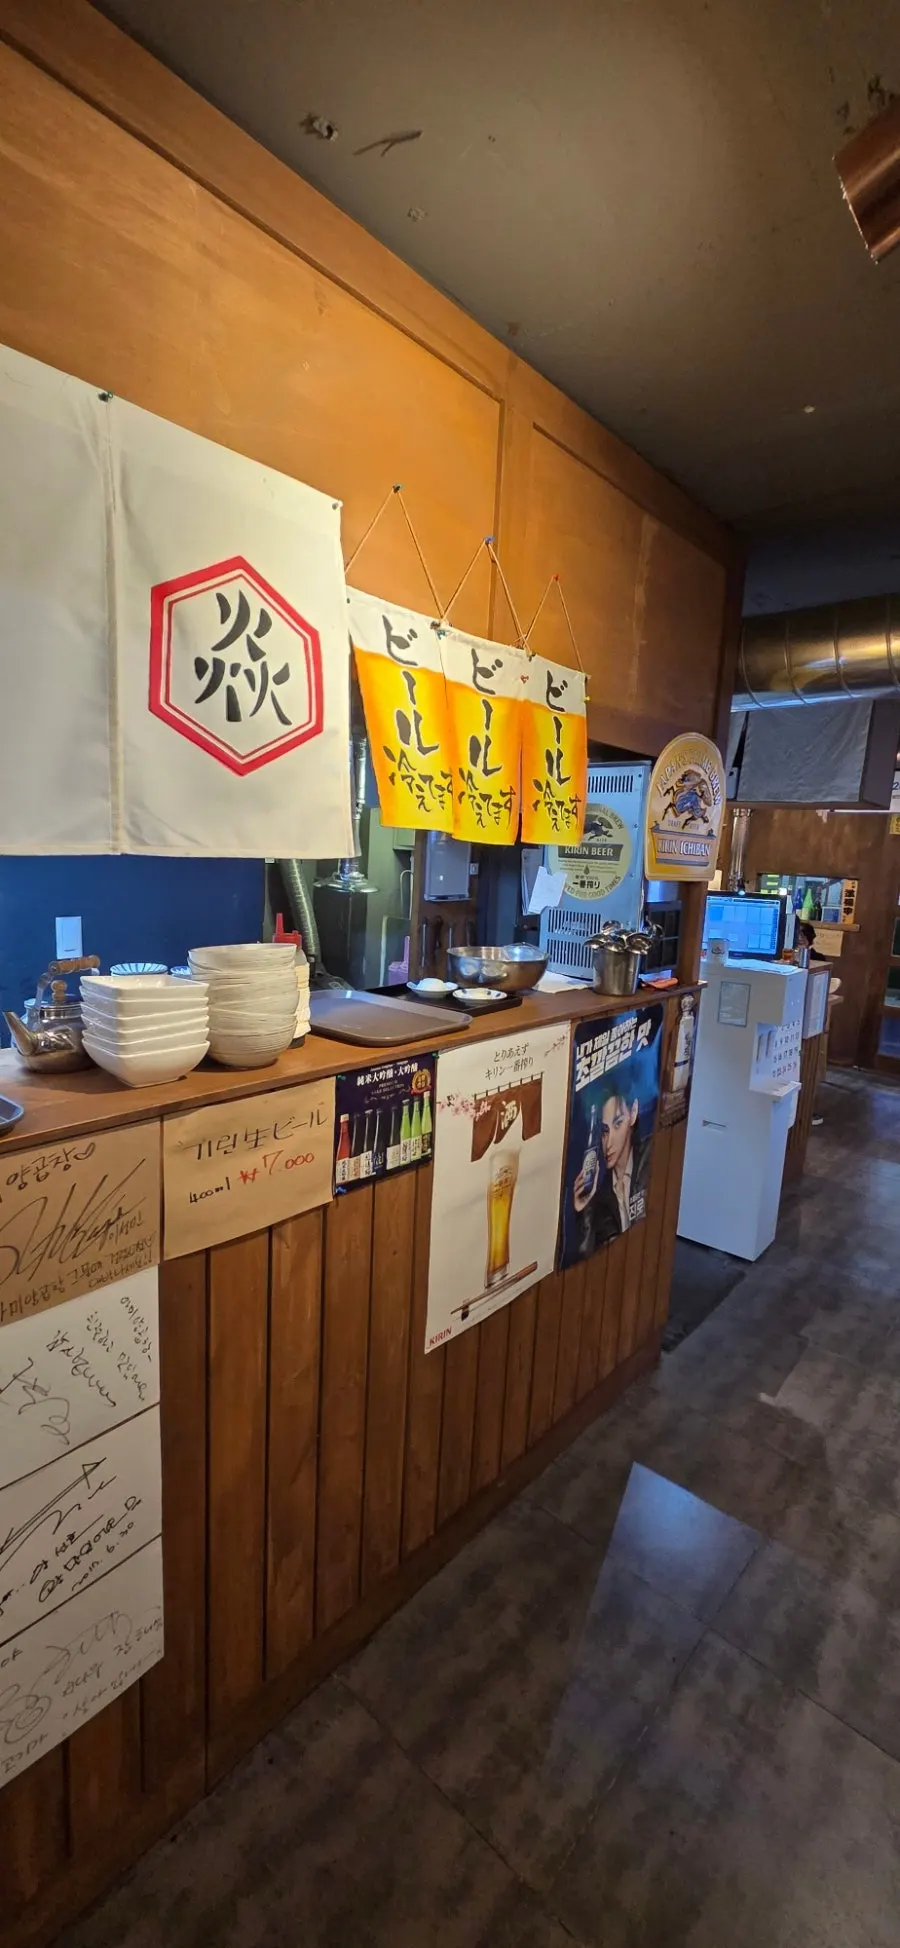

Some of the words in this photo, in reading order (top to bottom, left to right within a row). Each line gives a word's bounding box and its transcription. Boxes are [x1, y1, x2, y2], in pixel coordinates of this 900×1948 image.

[382, 614, 440, 756] ビール
[469, 648, 504, 777] ビール
[545, 669, 572, 786] ビール
[458, 767, 517, 830] 冷えてます
[532, 778, 582, 832] 冷えてます
[564, 845, 589, 855] KIRIN
[591, 848, 614, 857] BEER
[680, 838, 711, 857] ICHIBAN
[493, 1042, 530, 1063] とりあえず
[574, 1029, 635, 1092] 초깔끔한
[635, 1018, 652, 1053] 맛
[428, 1327, 452, 1347] KIRIN
